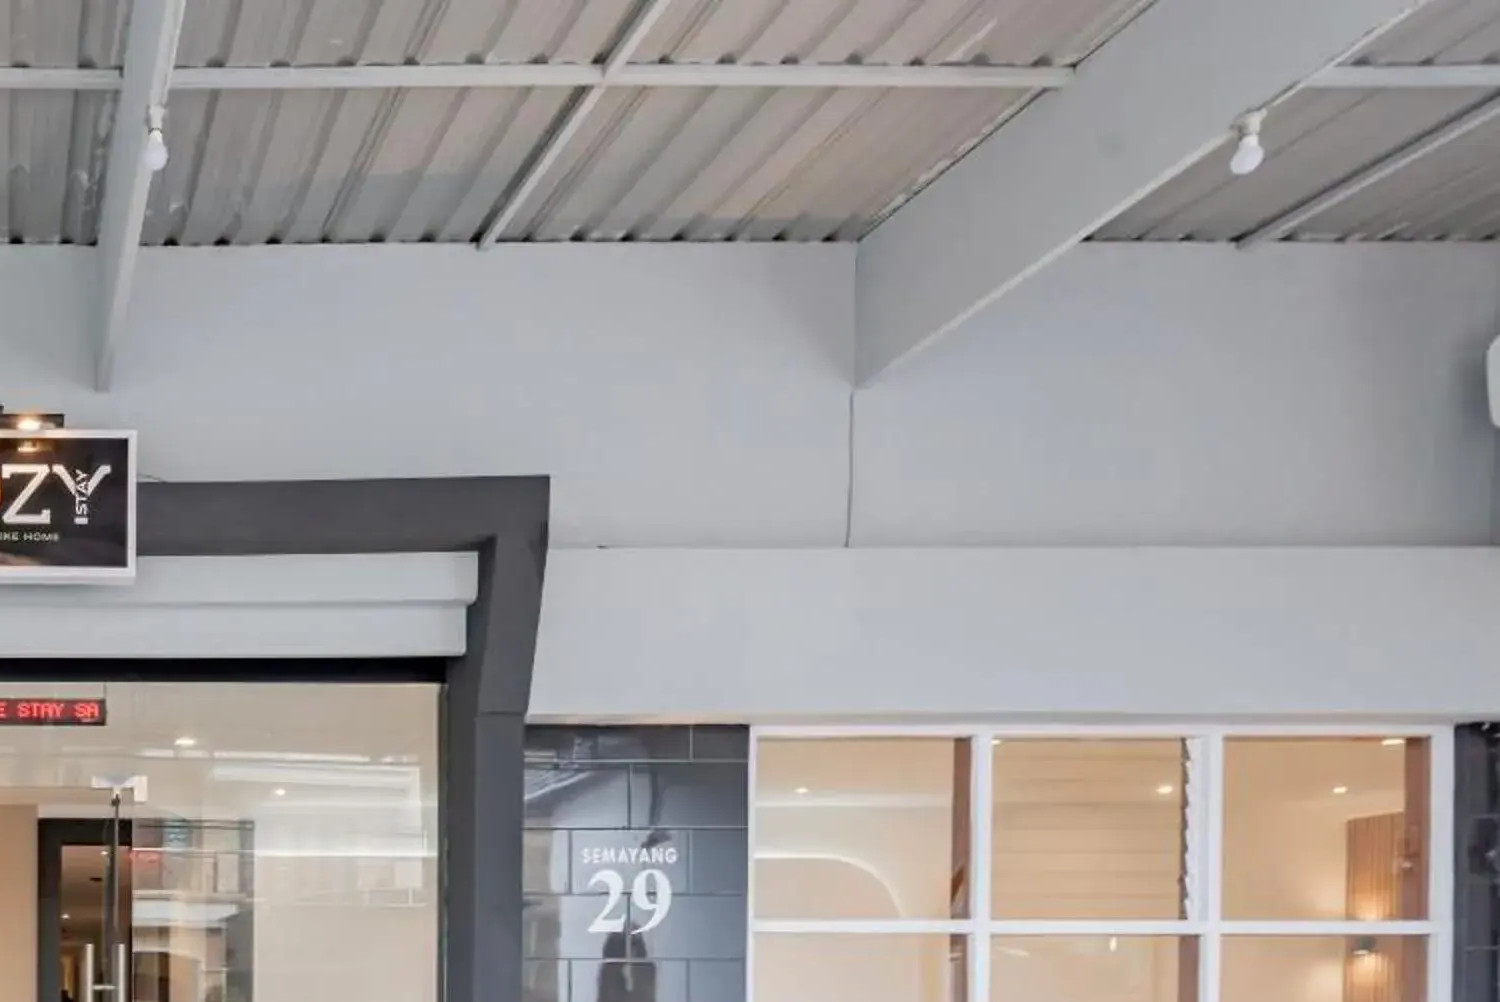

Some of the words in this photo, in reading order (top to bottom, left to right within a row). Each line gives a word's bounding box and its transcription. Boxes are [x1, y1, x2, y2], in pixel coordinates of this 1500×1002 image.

[75, 469, 88, 515] STAY
[23, 532, 59, 541] HOME
[17, 702, 64, 718] STAY
[74, 702, 99, 718] SA
[582, 847, 678, 864] SEMAYANG
[587, 868, 672, 935] 29
